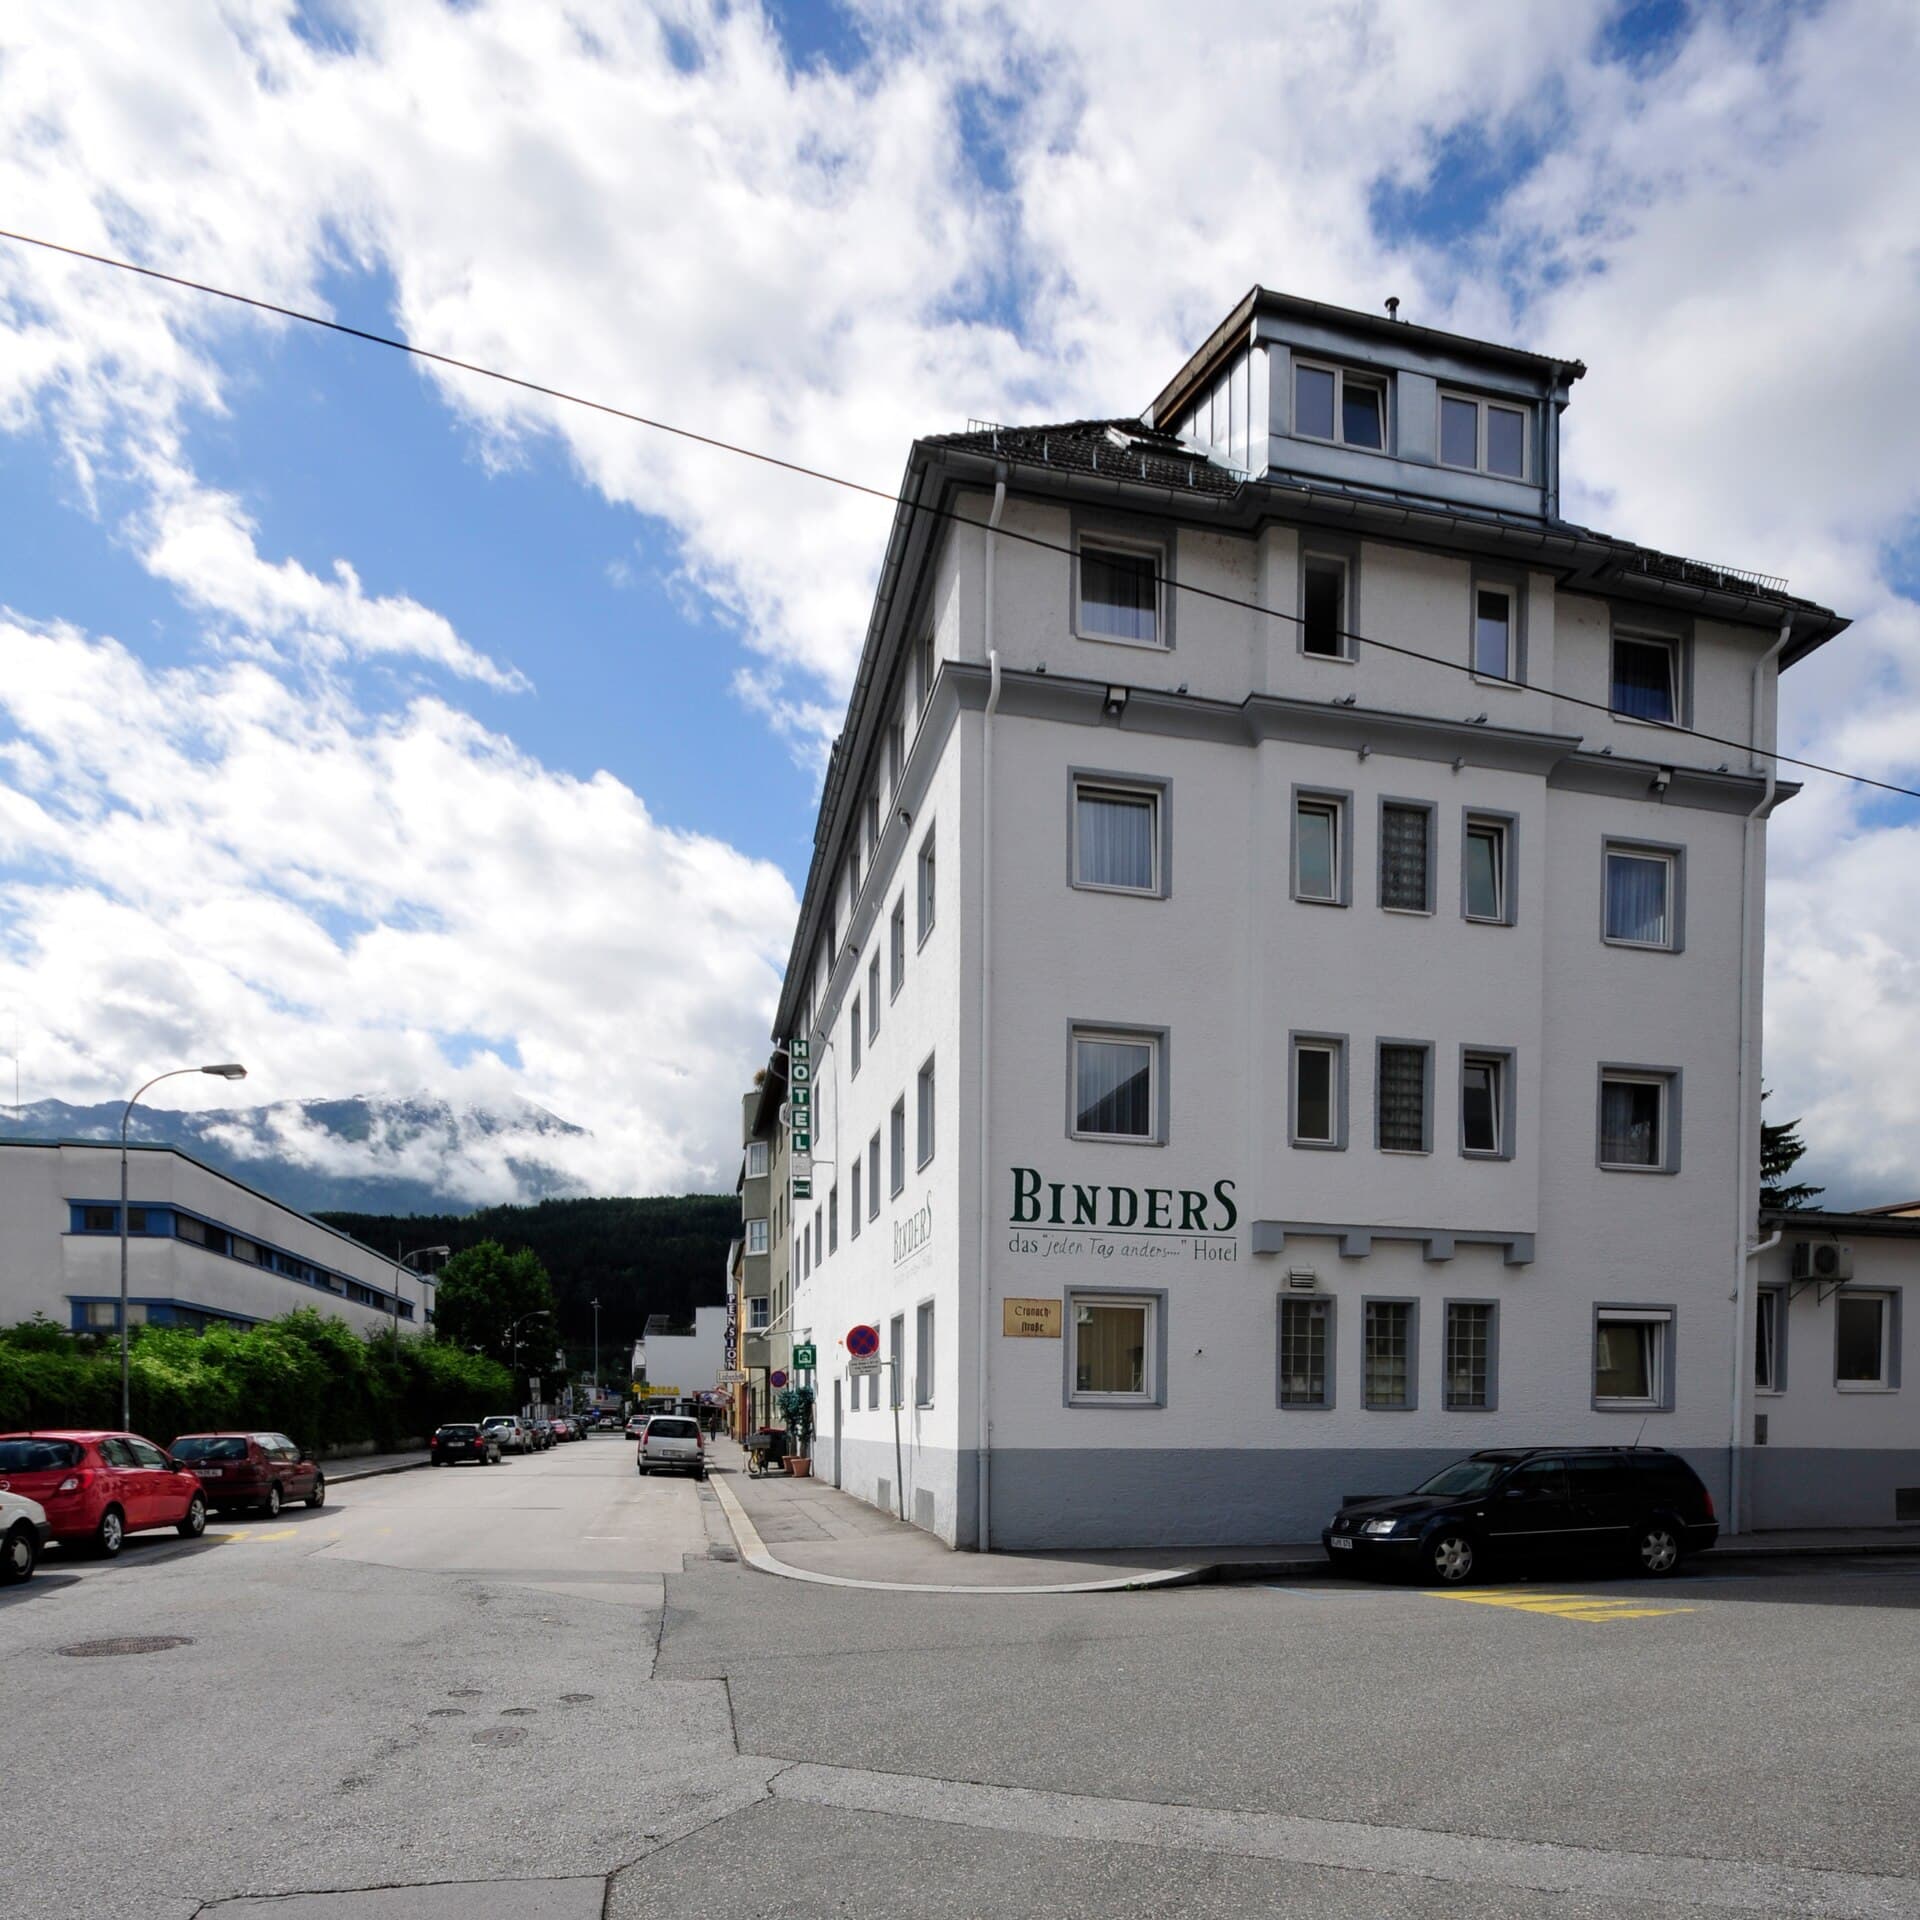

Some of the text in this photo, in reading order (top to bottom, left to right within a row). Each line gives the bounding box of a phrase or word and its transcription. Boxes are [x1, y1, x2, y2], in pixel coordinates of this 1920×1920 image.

[793, 1043, 809, 1150] HOTEL
[894, 1190, 931, 1263] BINDERS
[1009, 1167, 1237, 1231] BINDERS
[1009, 1233, 1038, 1253] das
[1088, 1238, 1114, 1259] Tag
[1194, 1240, 1237, 1261] Hotel
[727, 1294, 737, 1370] PENSION
